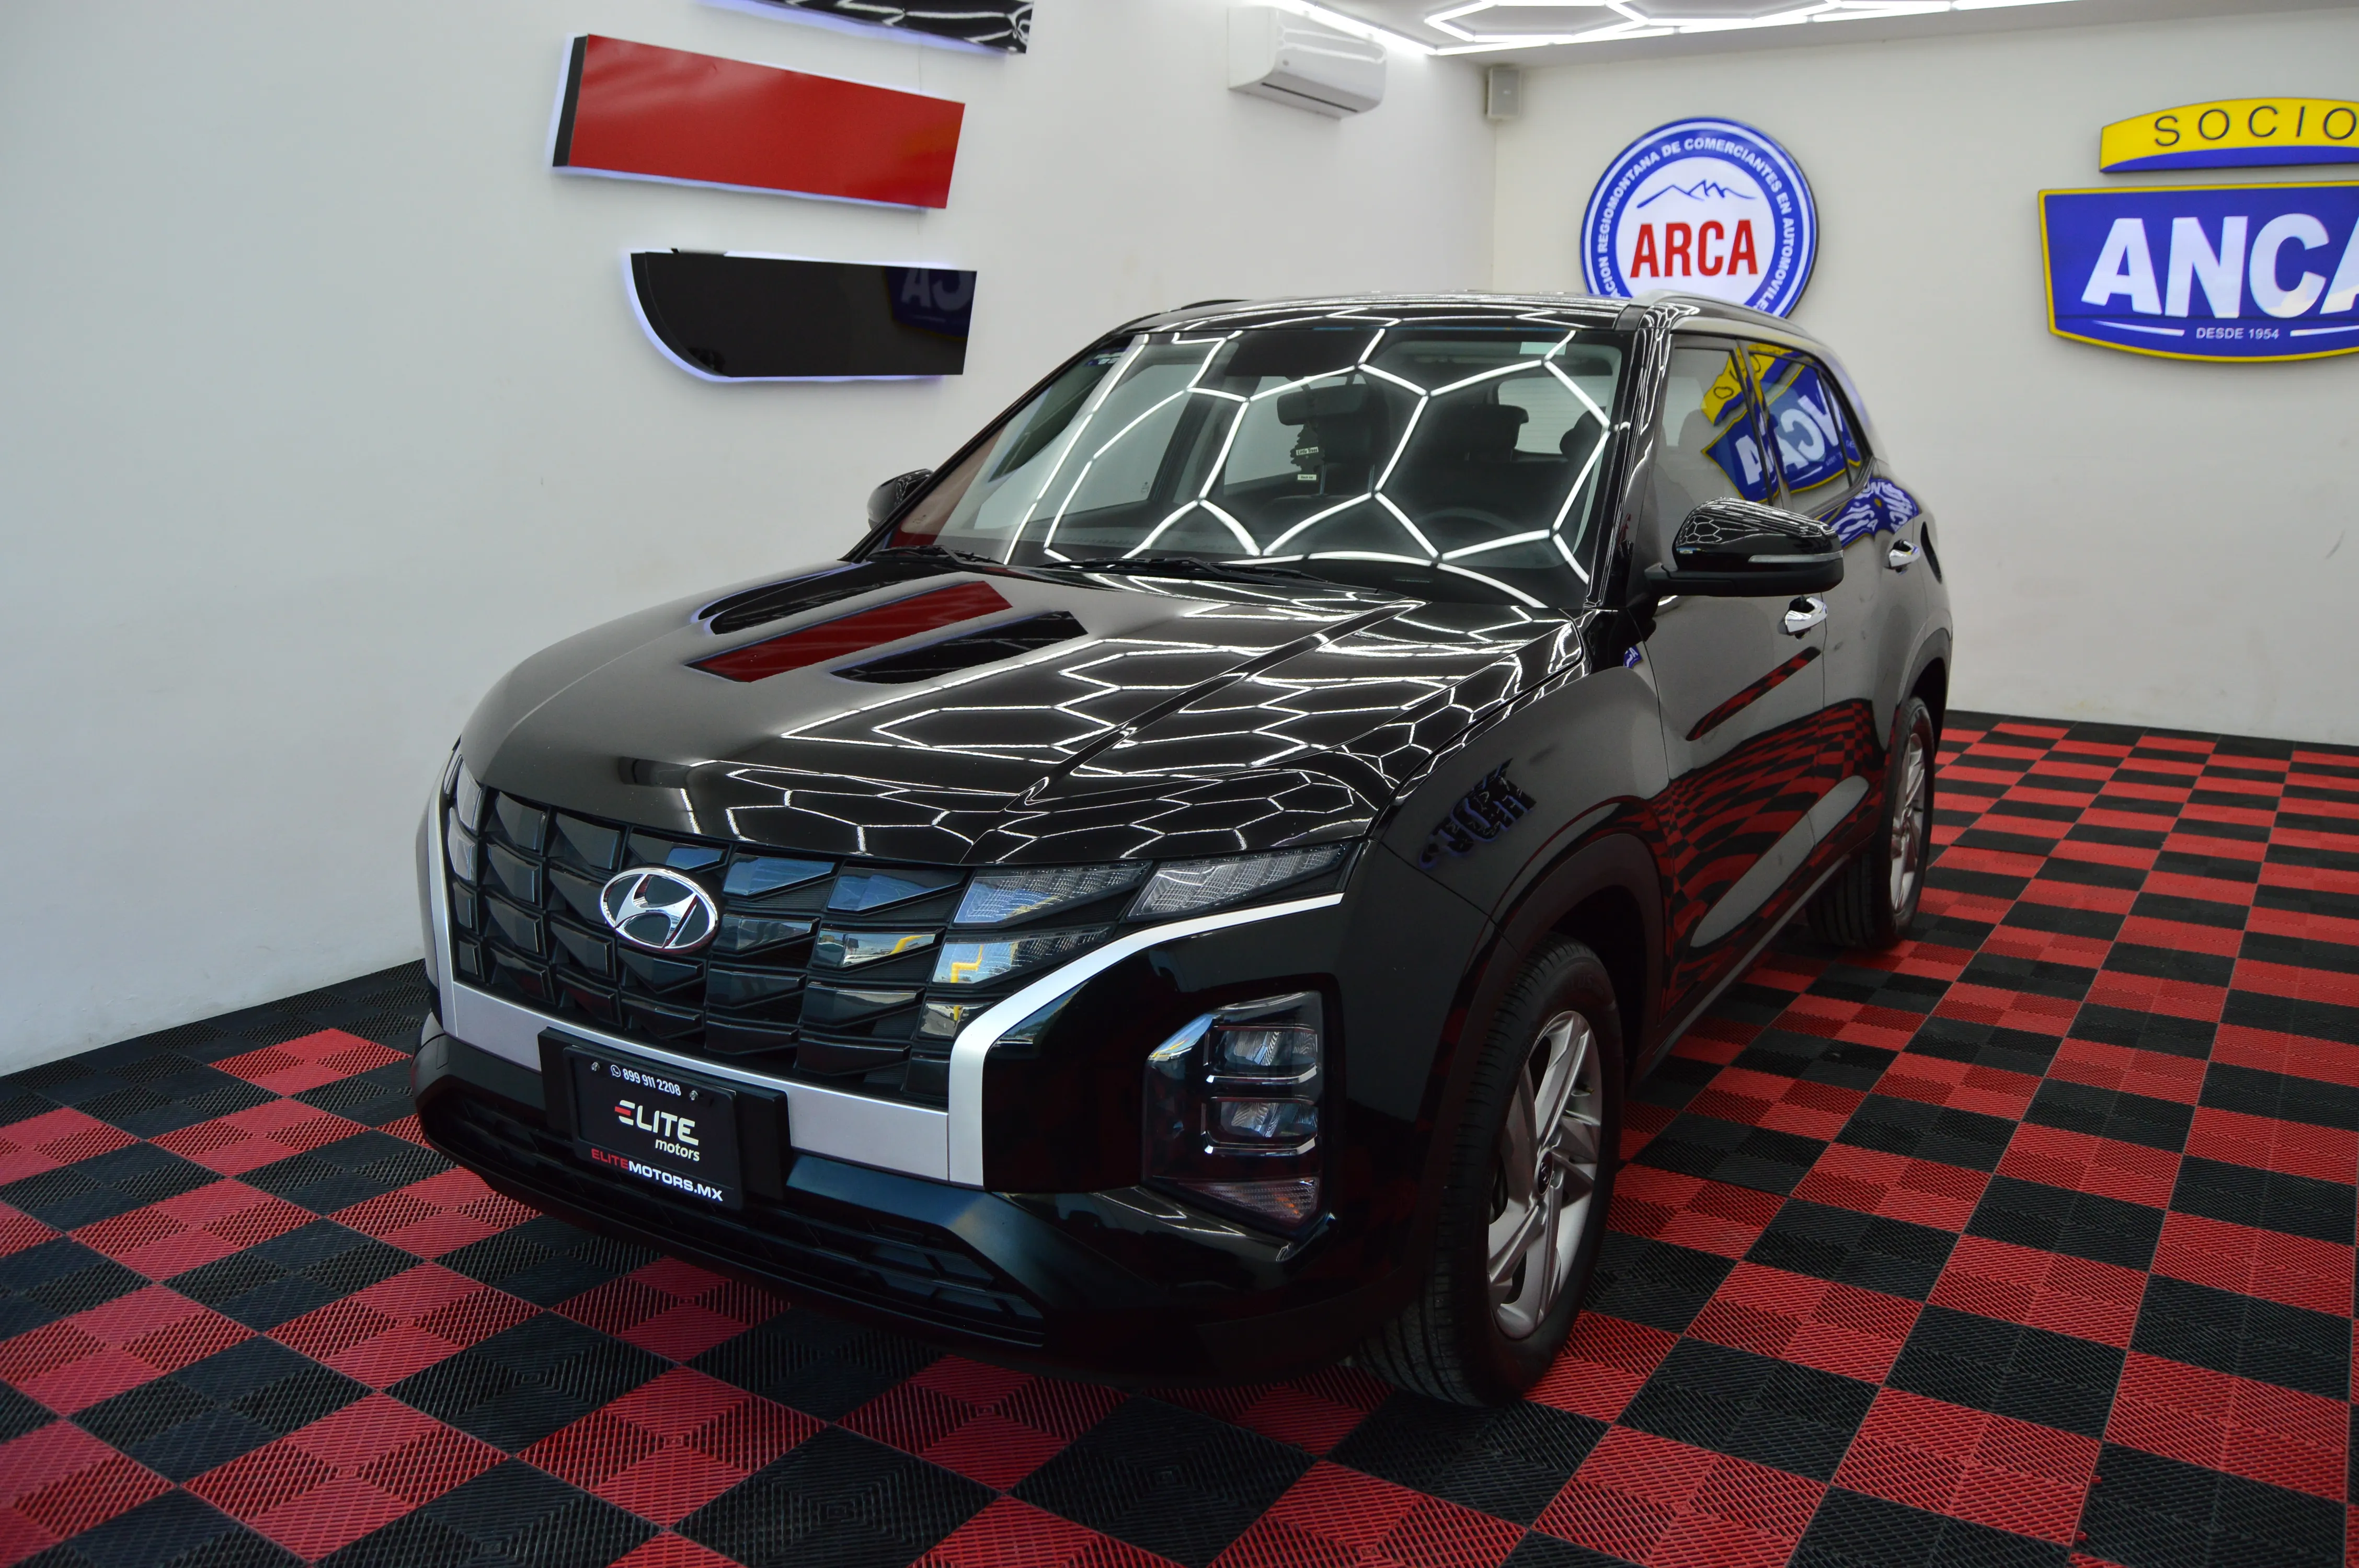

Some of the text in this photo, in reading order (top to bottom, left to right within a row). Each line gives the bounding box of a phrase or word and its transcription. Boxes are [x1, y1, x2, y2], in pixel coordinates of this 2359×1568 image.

[2154, 106, 2357, 147] SOCIO
[1661, 141, 1681, 157] DE
[1684, 137, 1782, 193] COMERCIANTES
[1597, 151, 1661, 254] REGIOMONTANA
[1776, 192, 1792, 215] EN
[1630, 219, 1758, 278] ARCA
[1753, 217, 1795, 311] AUTOMOVILE
[2196, 327, 2280, 340] DESDE 1954
[623, 1068, 681, 1096] 899 911 2208
[614, 1100, 699, 1146] ELITE
[655, 1139, 700, 1161] motors
[591, 1148, 723, 1201] ELITEMOTORS.MX
